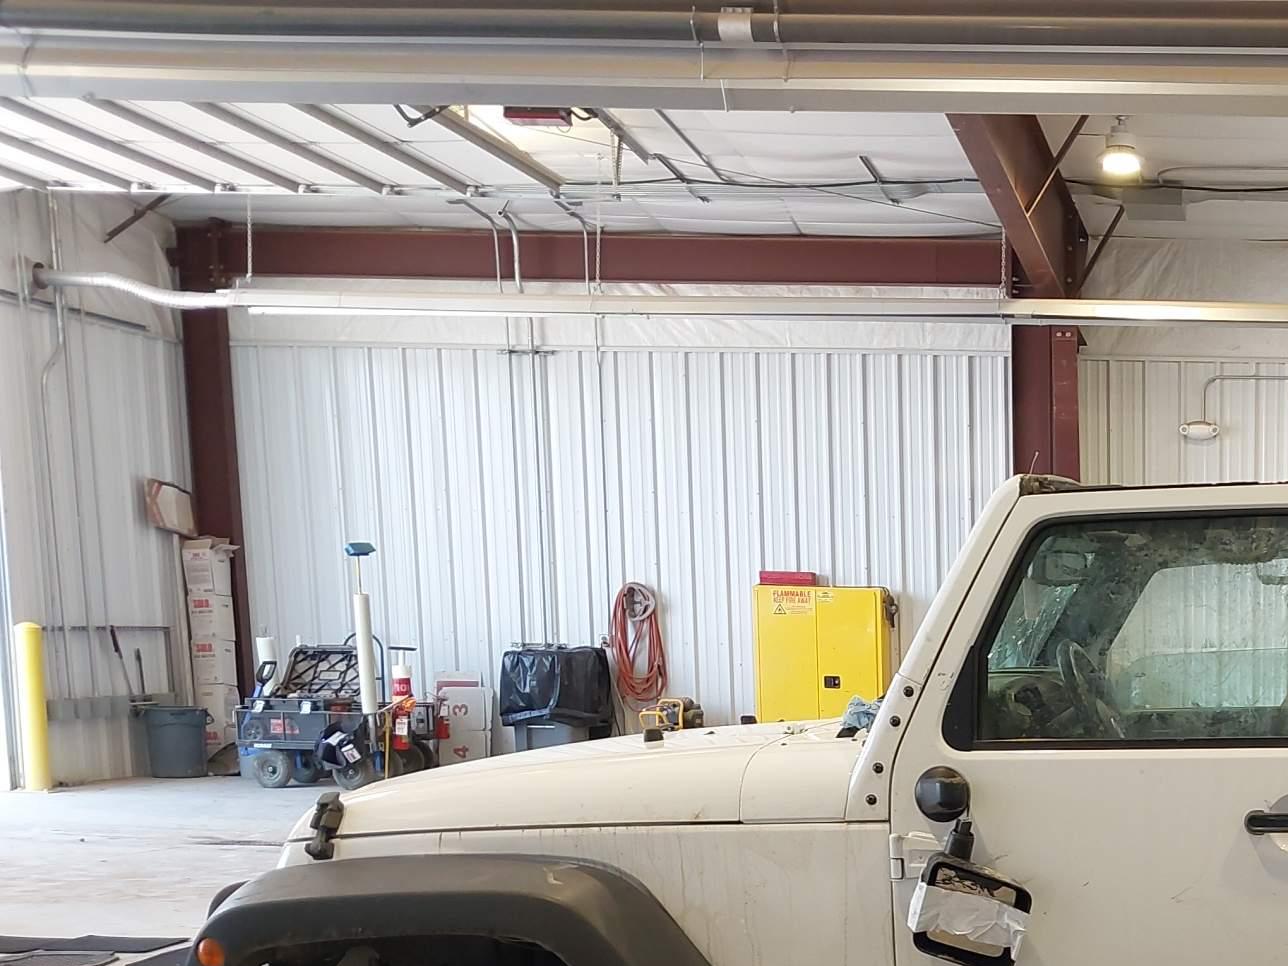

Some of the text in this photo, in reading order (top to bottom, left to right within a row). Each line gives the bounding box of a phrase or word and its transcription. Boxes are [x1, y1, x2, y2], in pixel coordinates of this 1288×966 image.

[773, 590, 811, 598] FLAMMABLE
[453, 703, 468, 717] 3
[453, 744, 469, 759] 4
